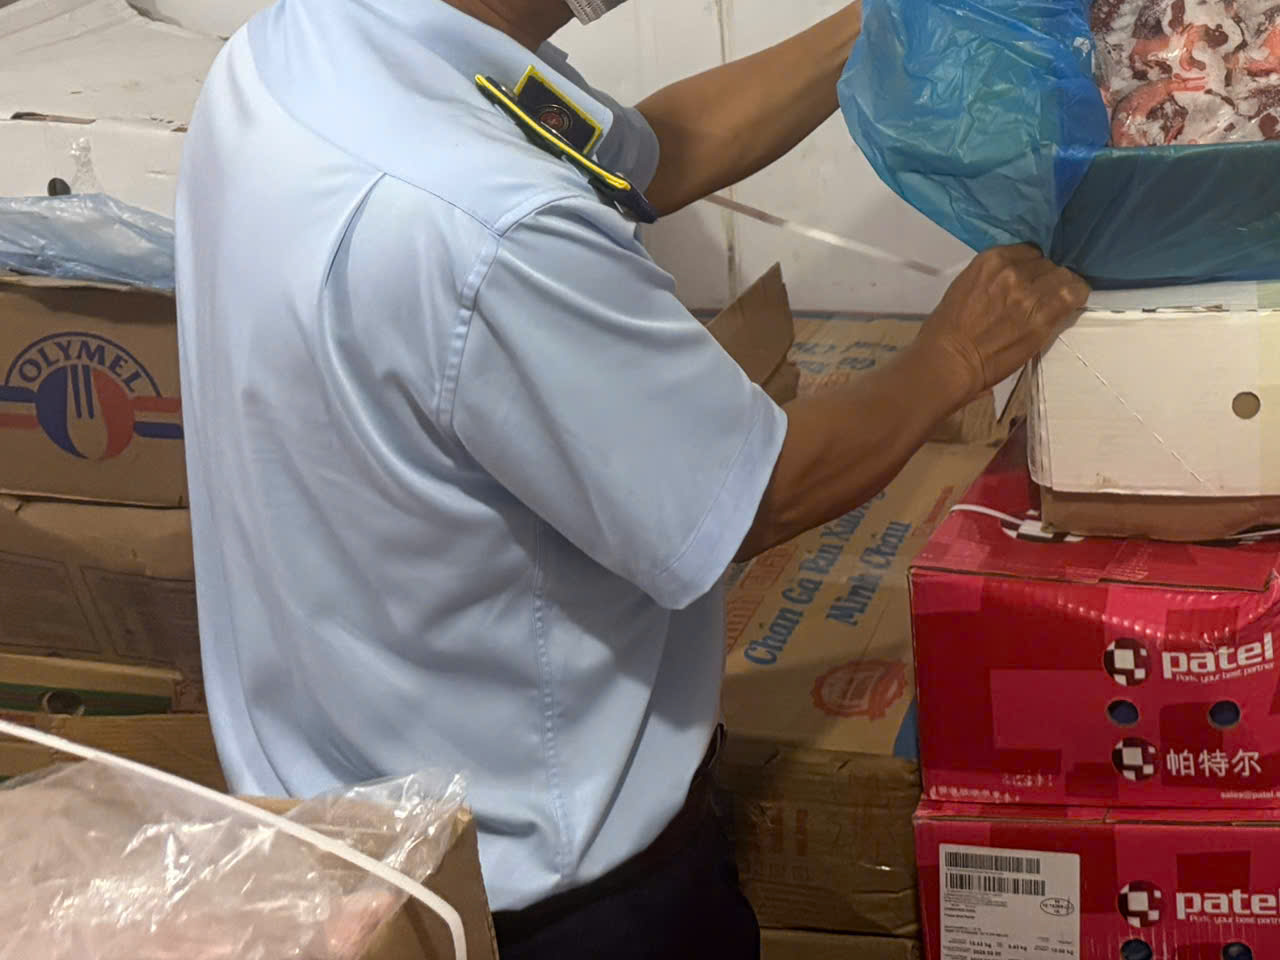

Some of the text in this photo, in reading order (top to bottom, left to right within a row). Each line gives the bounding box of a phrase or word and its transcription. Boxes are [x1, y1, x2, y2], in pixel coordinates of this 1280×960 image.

[18, 339, 144, 393] OLYMEL
[825, 574, 882, 627] Minh
[1161, 631, 1274, 680] patel
[1166, 748, 1262, 777] 帕特尔
